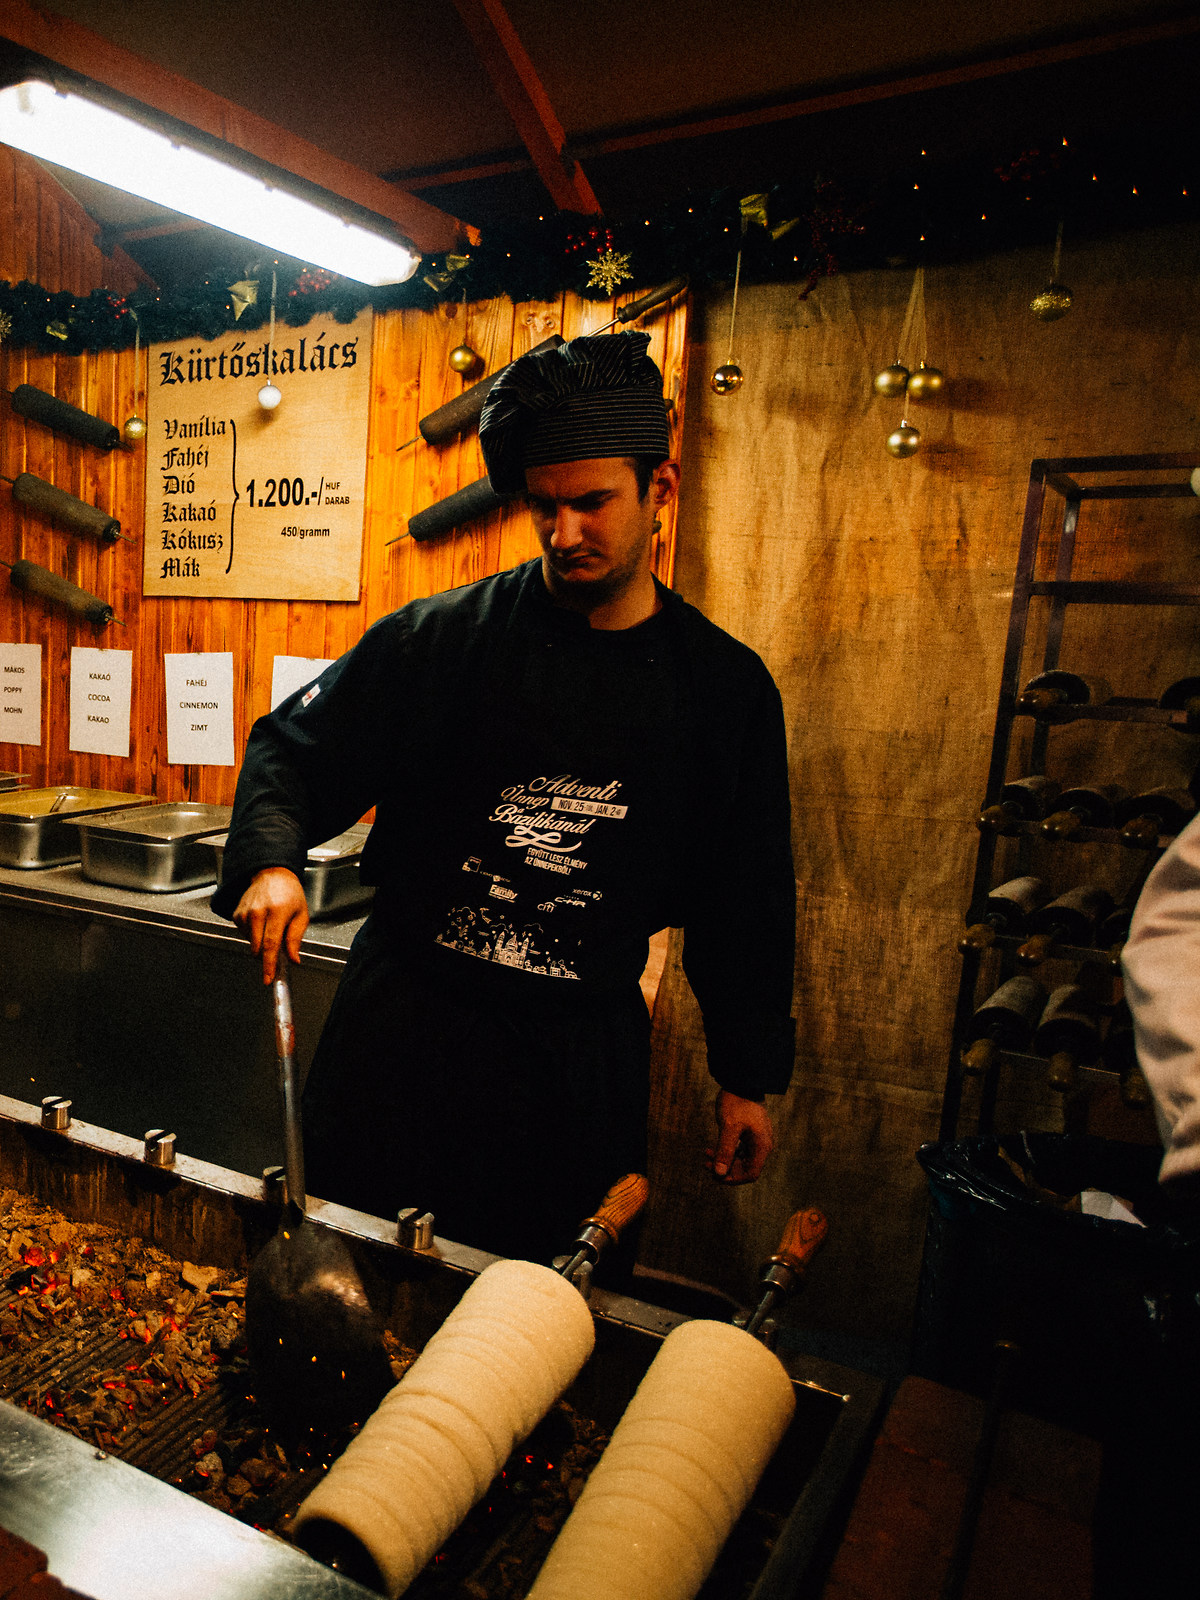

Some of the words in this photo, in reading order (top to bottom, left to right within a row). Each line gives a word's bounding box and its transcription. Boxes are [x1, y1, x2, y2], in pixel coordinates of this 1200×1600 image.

[159, 331, 359, 386] Kürtőskalács
[163, 415, 226, 439] Vanília
[160, 444, 209, 470] Fahéj
[162, 472, 195, 495] Dió
[325, 482, 341, 490] HUF
[325, 496, 350, 505] DARAB
[162, 499, 216, 523] Kakaó
[161, 528, 224, 553] Kókusz
[160, 556, 201, 579] Mák
[3, 665, 25, 674] MÁKOS
[88, 672, 111, 681] KAKAÓ
[185, 677, 208, 687] FAHÉJ
[3, 686, 23, 694] POPPY
[87, 693, 111, 702] COCOA
[3, 706, 23, 714] MOHN
[179, 701, 219, 710] CINNEMON
[87, 715, 110, 724] KAKAO
[190, 723, 209, 731] ZIMT
[528, 774, 622, 801] Adventi
[500, 784, 550, 810] Ünnep
[488, 803, 597, 834] Bazilikánál
[524, 856, 534, 865] AZ
[527, 847, 550, 860] EGYÜTT
[549, 853, 565, 864] LESZ
[563, 858, 588, 870] ÉLMÉNY
[490, 884, 518, 900] Family
